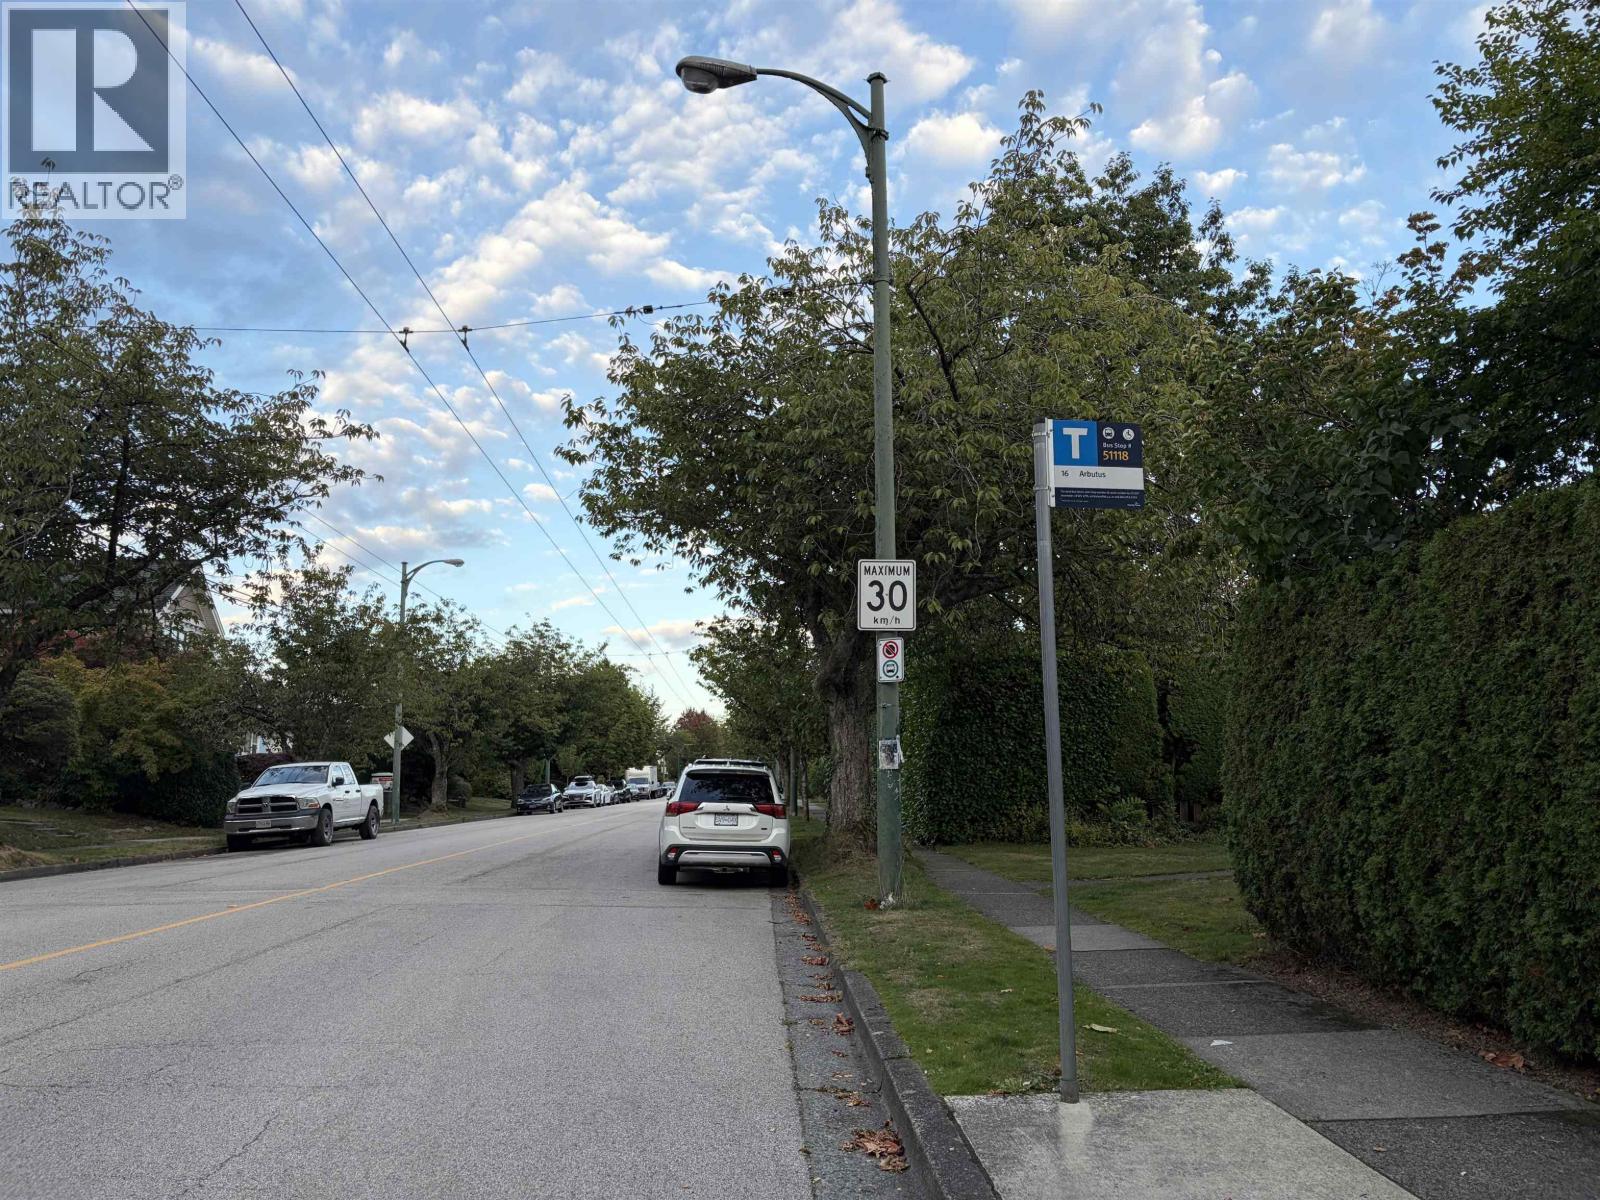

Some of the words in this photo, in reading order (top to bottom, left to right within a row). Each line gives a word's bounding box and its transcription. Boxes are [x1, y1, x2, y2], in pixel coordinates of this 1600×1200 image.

[1062, 427, 1088, 459] T
[1103, 450, 1129, 461] 51118
[1079, 470, 1106, 478] Arbutus
[863, 565, 910, 576] MAXIMUM
[866, 580, 908, 612] 30
[873, 615, 901, 626] km/h
